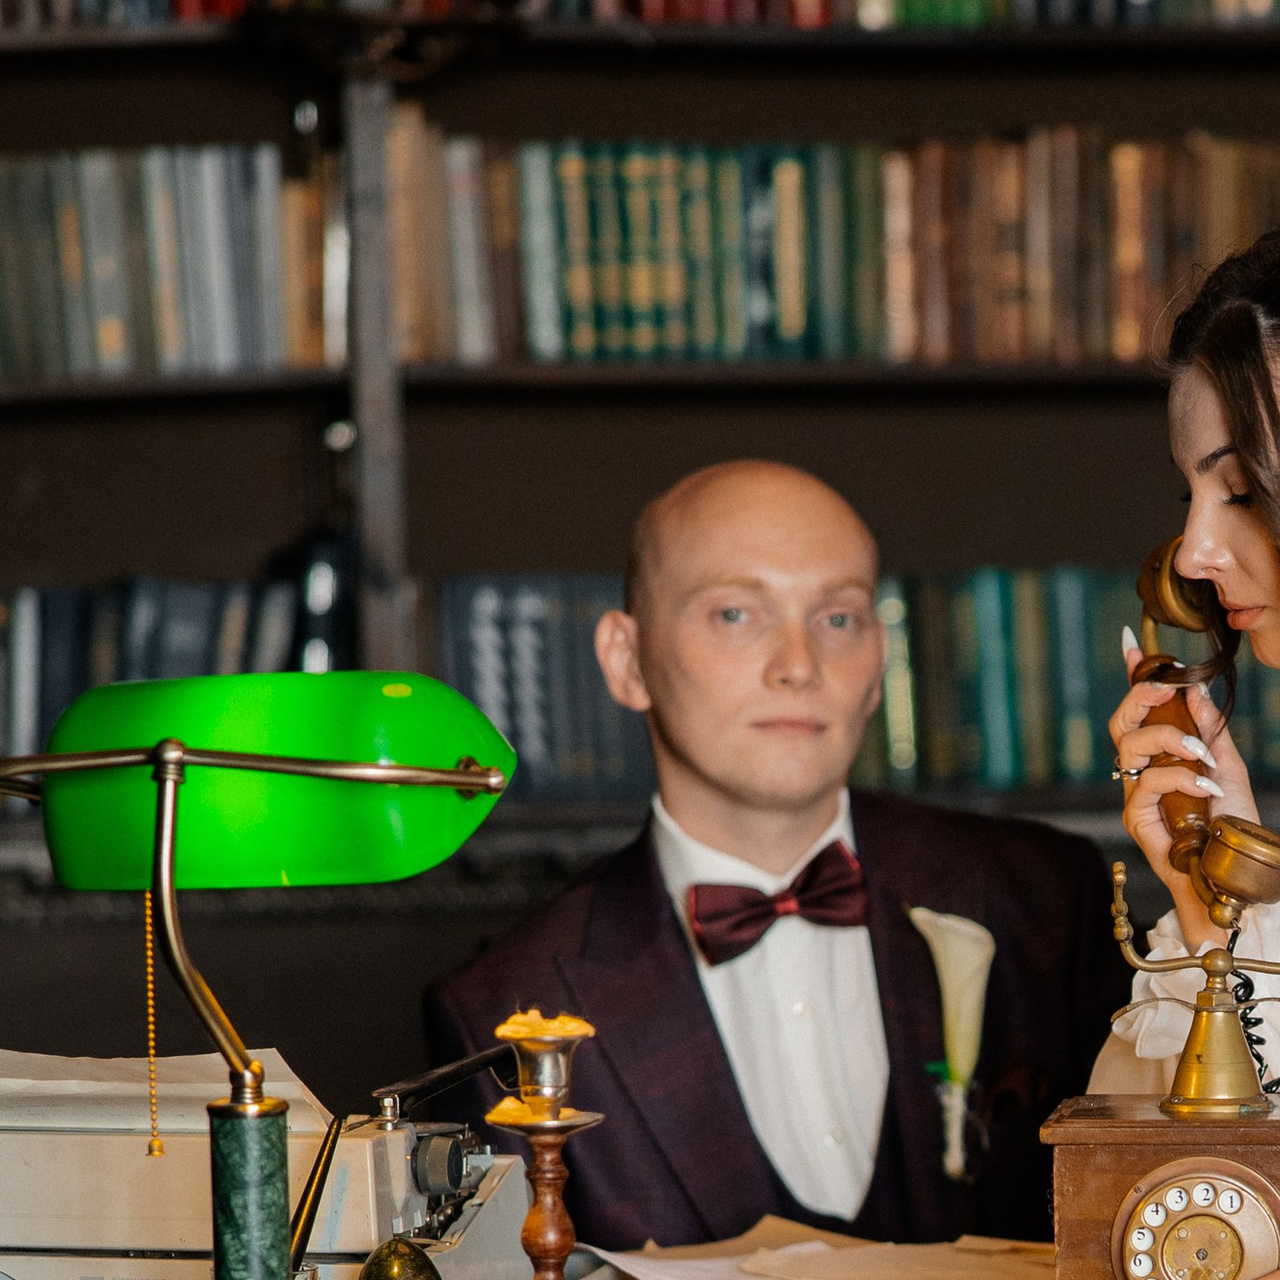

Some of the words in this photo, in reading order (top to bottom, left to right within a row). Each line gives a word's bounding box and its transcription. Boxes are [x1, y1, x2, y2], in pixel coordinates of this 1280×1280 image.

[1174, 1190, 1183, 1204] 3
[1202, 1188, 1210, 1202] 2
[1151, 1203, 1160, 1215] 4
[1136, 1227, 1145, 1240] 5
[1133, 1254, 1142, 1267] 6
